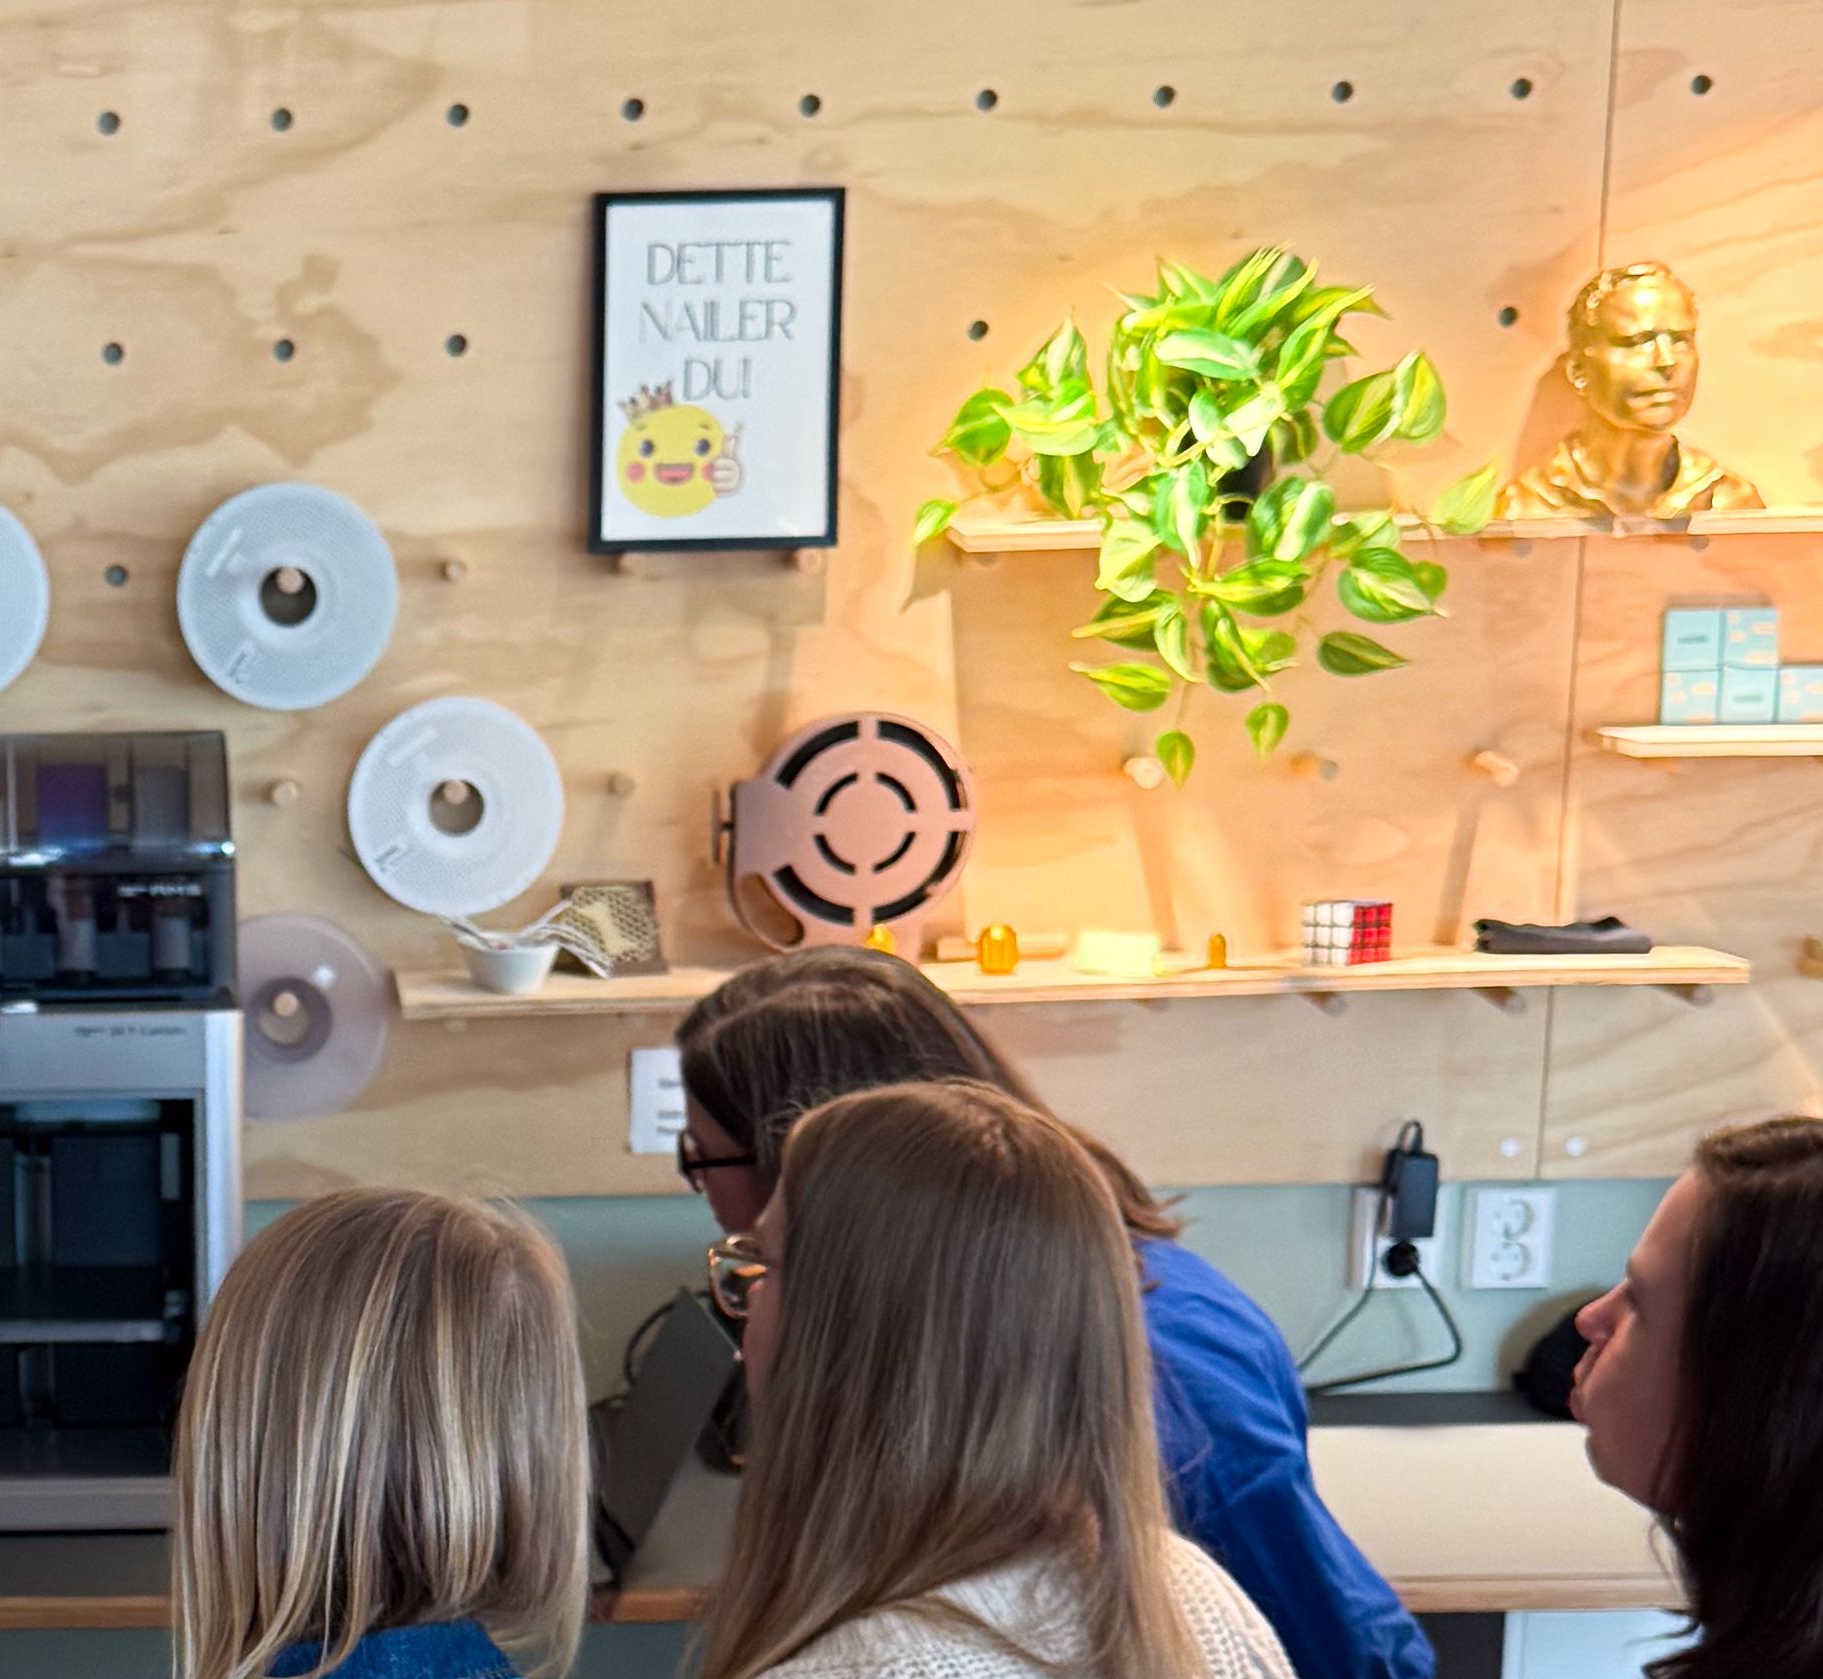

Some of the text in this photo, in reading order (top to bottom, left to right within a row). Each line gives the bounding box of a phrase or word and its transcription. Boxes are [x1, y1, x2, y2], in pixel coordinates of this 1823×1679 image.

[646, 240, 795, 286] DETTE
[638, 299, 798, 343] NAILER
[682, 357, 753, 401] DU
